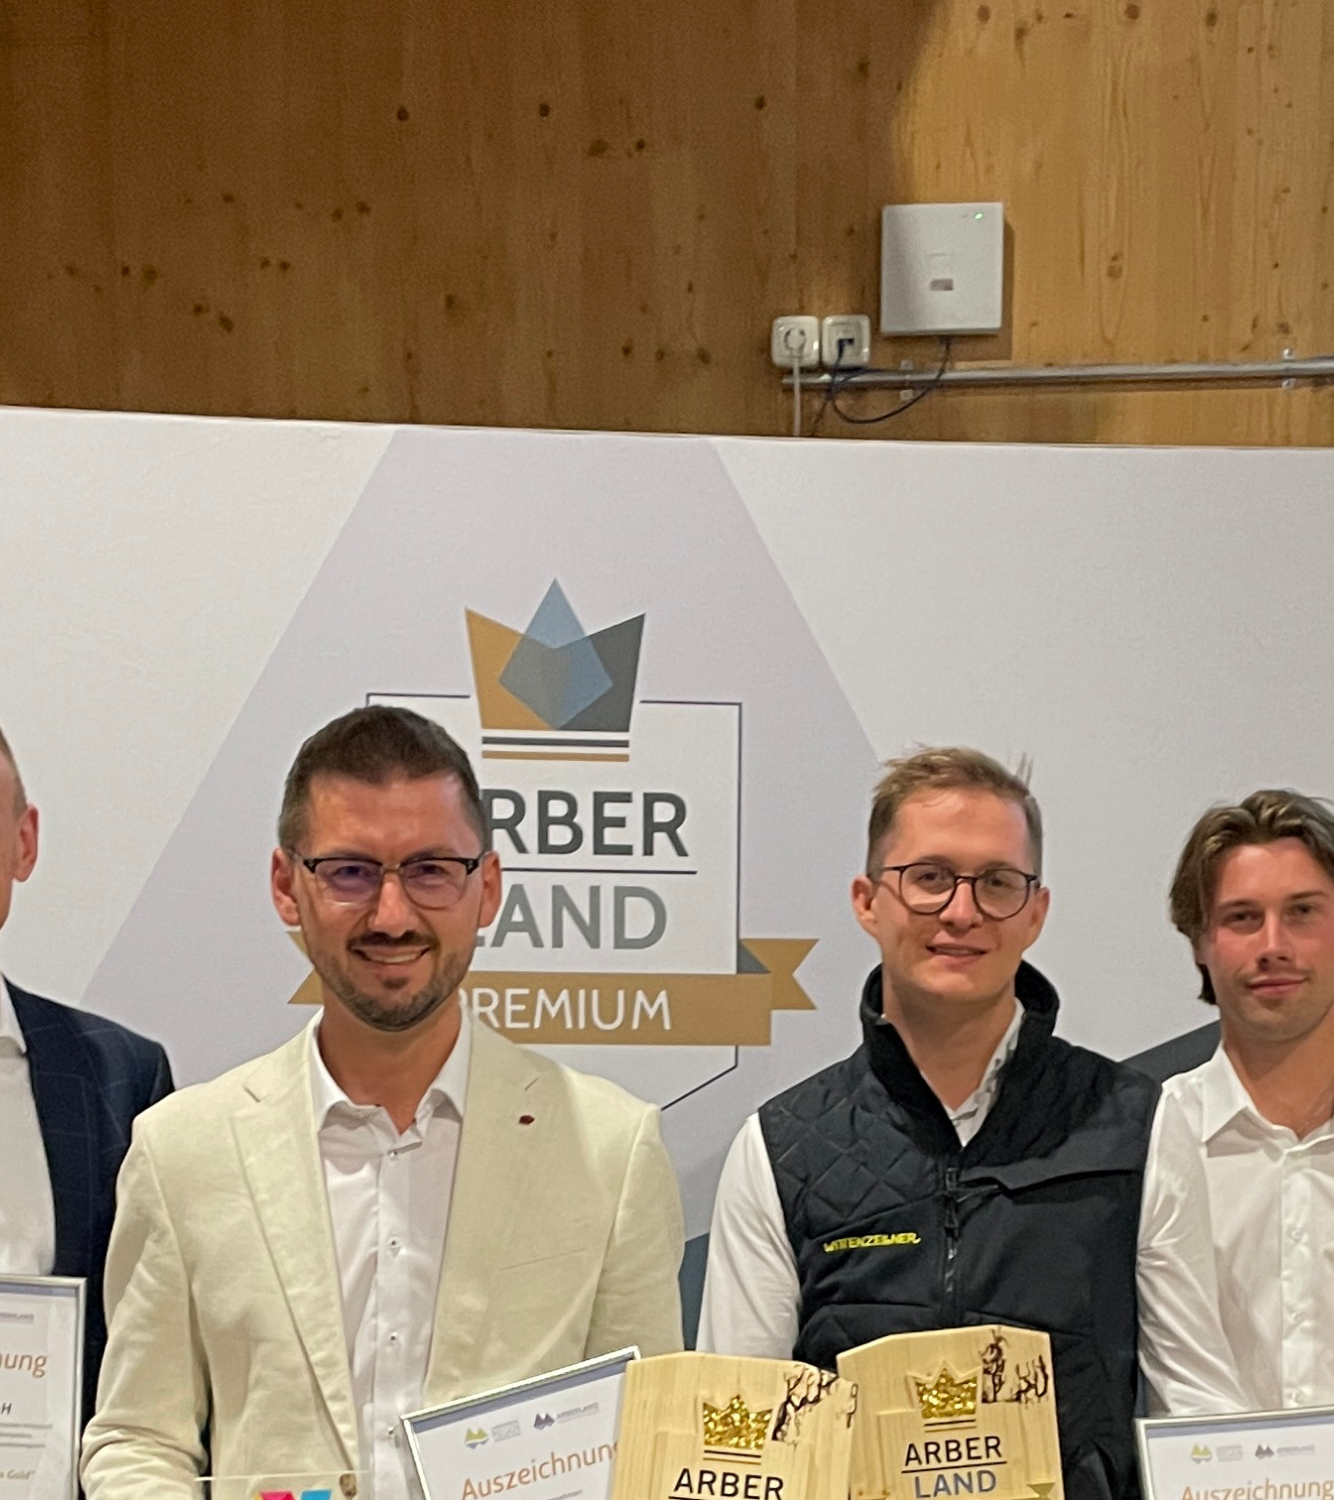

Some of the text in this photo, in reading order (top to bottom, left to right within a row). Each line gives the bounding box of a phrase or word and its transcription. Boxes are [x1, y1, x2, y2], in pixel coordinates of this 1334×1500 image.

[480, 788, 689, 858] RBER
[476, 883, 667, 950] AND
[904, 1435, 1002, 1467] ARBER
[914, 1469, 997, 1499] LAND
